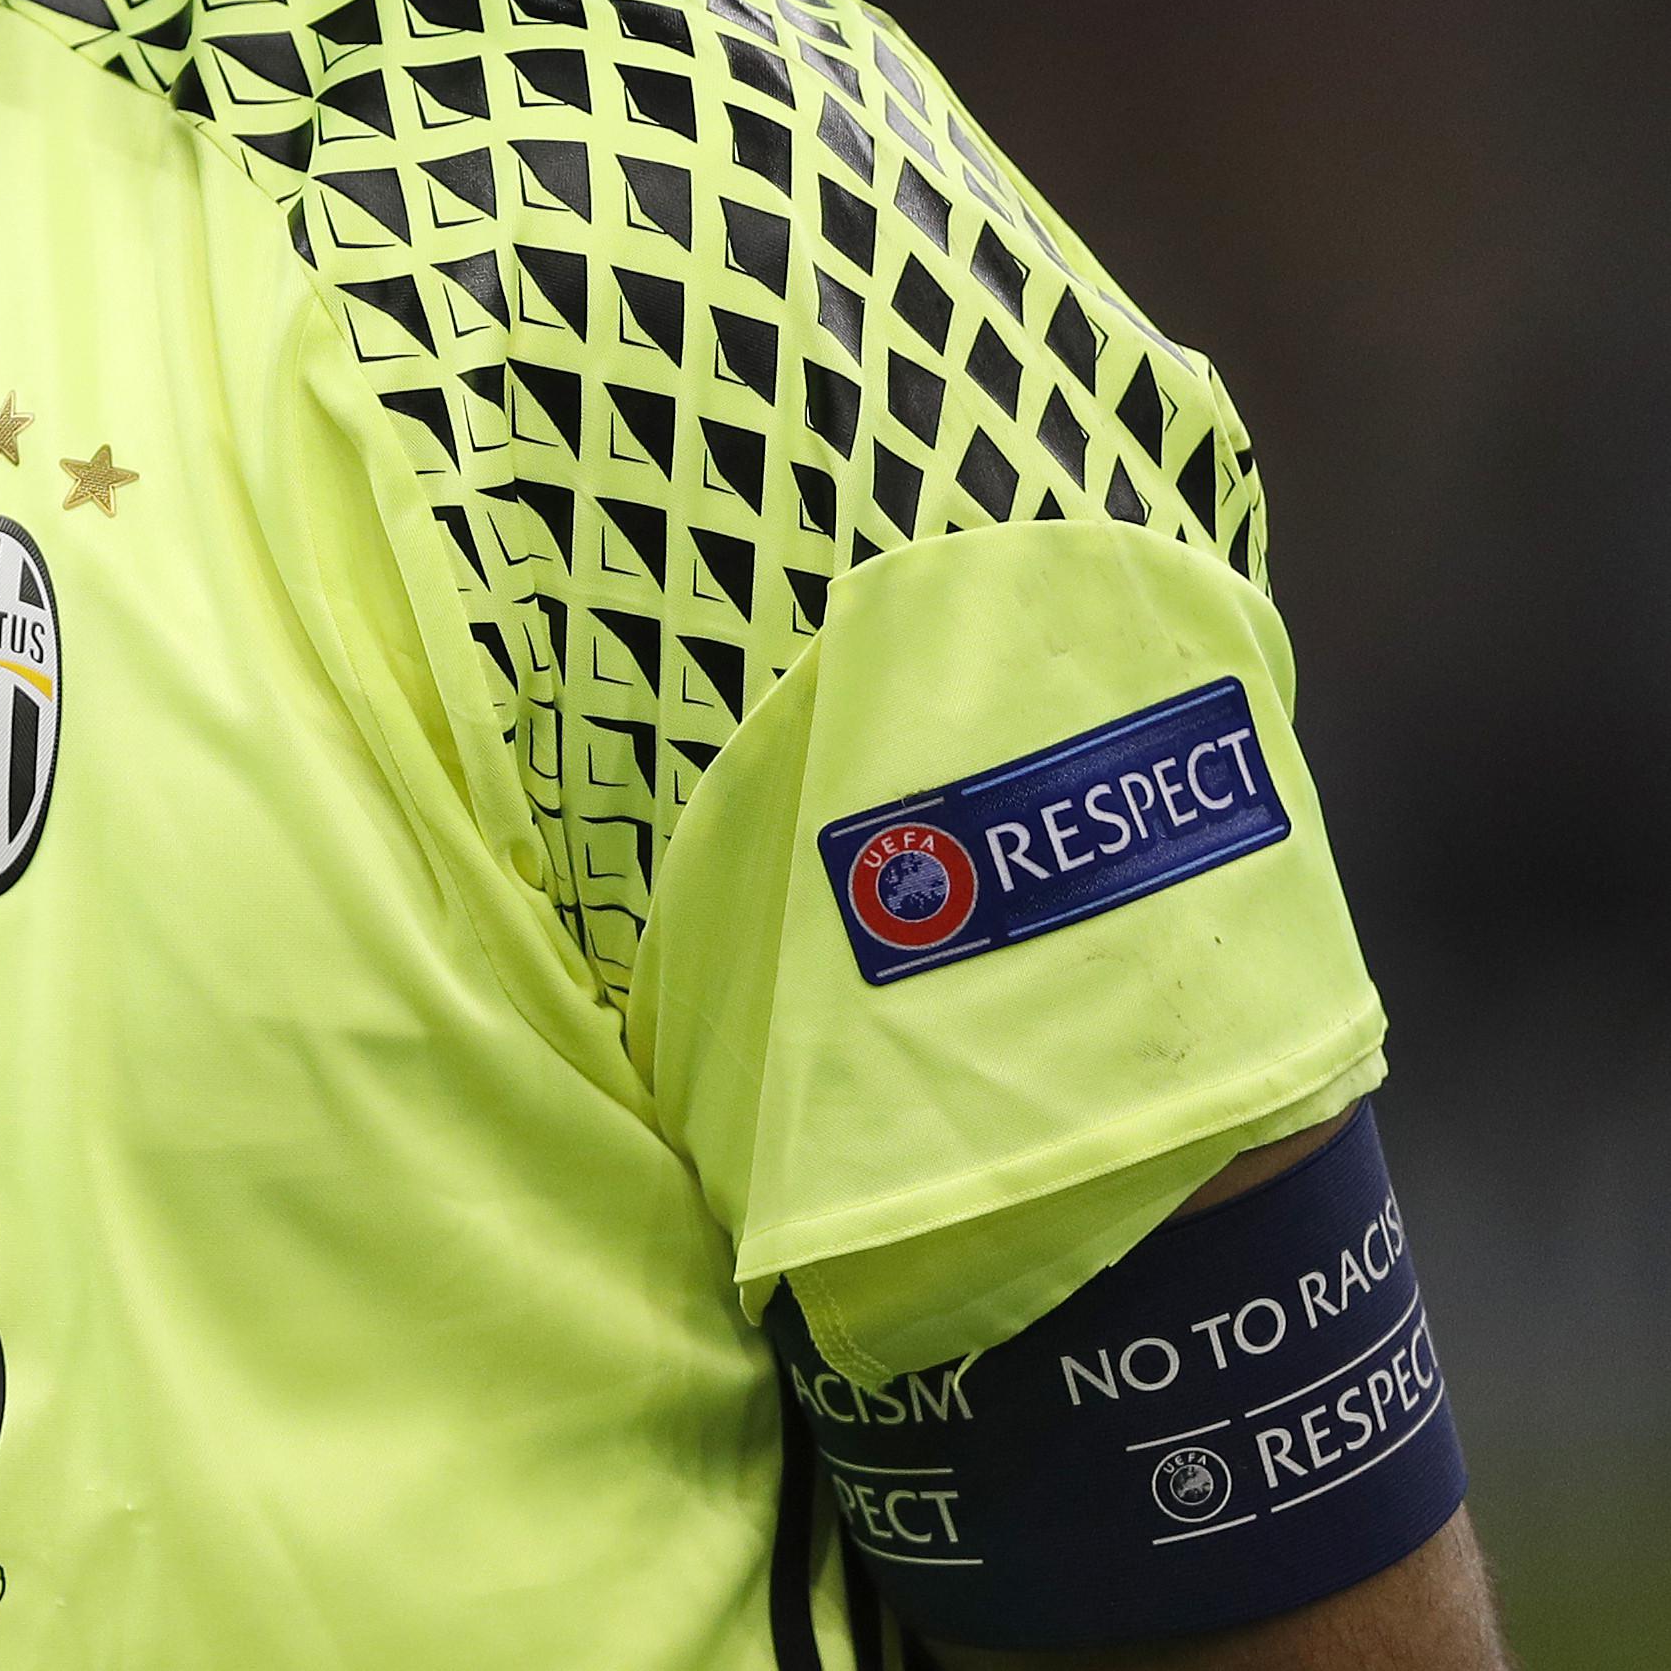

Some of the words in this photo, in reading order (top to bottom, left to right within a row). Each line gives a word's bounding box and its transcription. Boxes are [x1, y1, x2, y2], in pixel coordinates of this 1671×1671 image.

[863, 831, 936, 869] UEFA
[984, 728, 1258, 893] RESPECT
[1059, 1337, 1180, 1406] NO
[1191, 1297, 1287, 1370] TO
[1298, 1186, 1406, 1329] RACIS
[1163, 1452, 1208, 1475] UEFA
